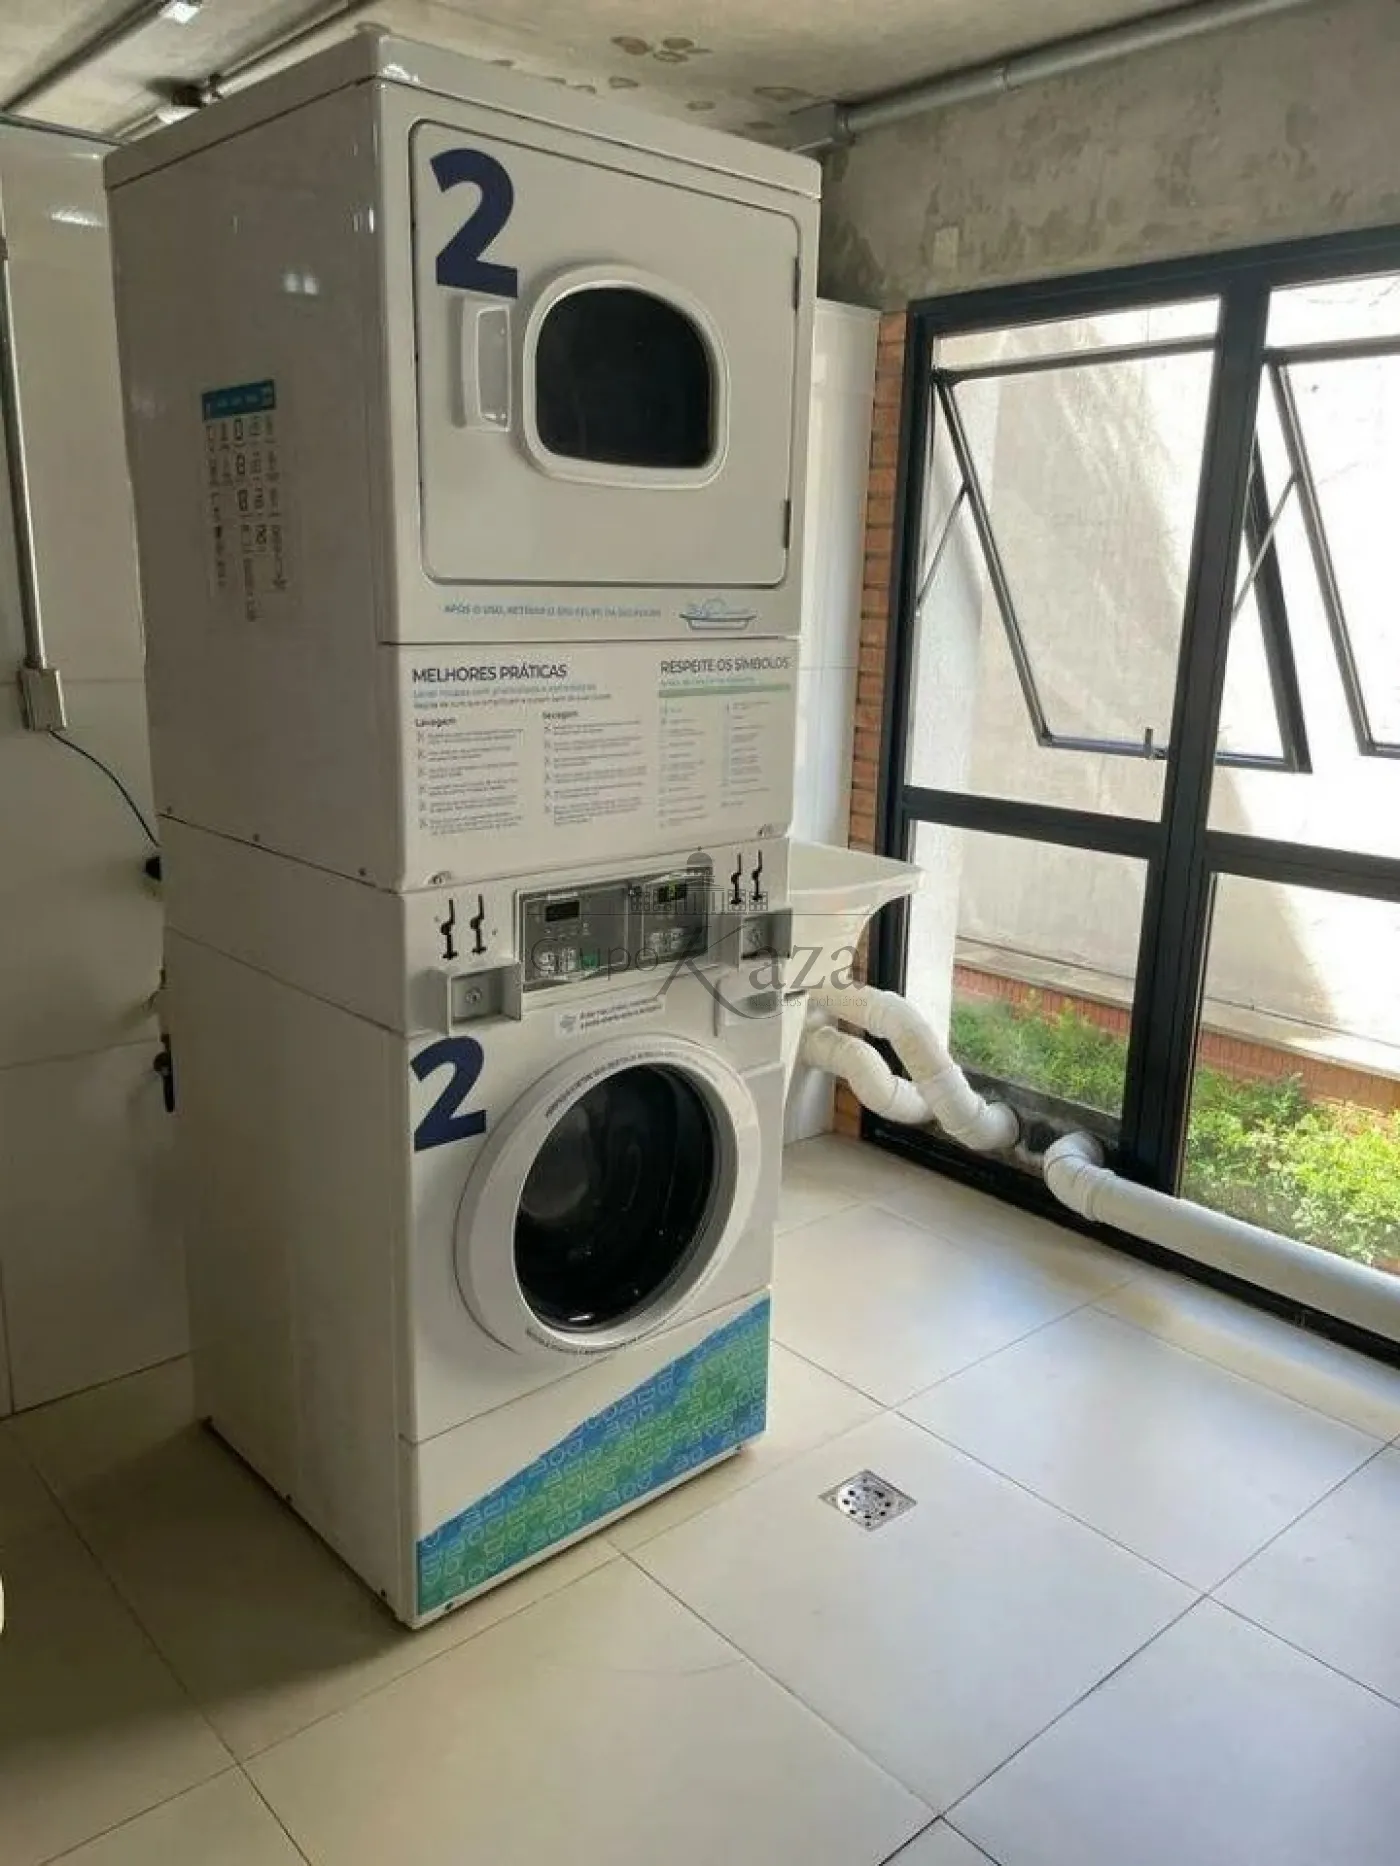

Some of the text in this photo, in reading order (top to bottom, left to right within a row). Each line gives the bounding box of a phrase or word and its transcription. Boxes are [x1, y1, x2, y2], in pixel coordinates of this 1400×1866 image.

[430, 148, 517, 298] 2
[412, 662, 568, 683] MELHORES PRÁTICAS
[660, 658, 716, 673] RESPEITE
[717, 658, 733, 672] OS
[410, 1036, 487, 1151] 2
